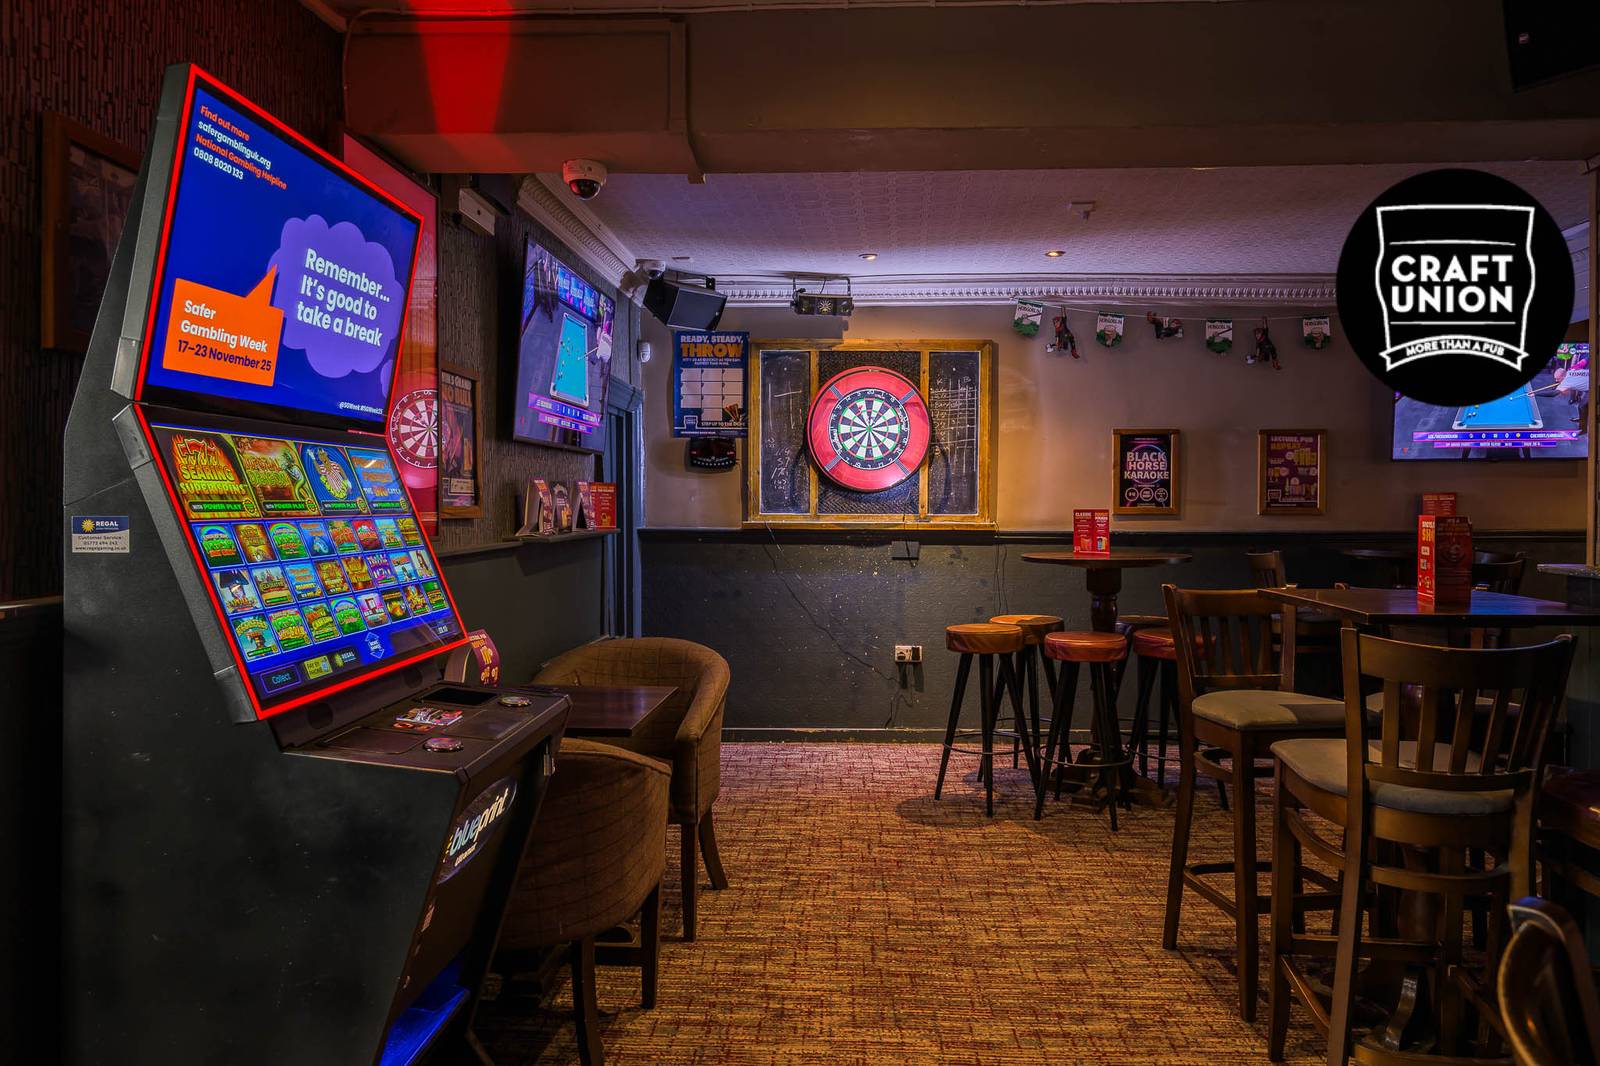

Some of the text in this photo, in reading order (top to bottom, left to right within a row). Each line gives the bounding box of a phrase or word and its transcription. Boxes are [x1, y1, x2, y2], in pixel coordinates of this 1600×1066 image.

[200, 105, 250, 141] Find out more
[198, 120, 272, 170] safergamblinguk.org
[194, 147, 244, 180] 0808 8020 133
[195, 133, 287, 190] National Gambling Helpline
[305, 248, 390, 302] Remember...
[184, 299, 216, 320] Safer
[326, 289, 363, 315] good
[364, 300, 377, 321] to
[297, 301, 383, 347] take a break
[181, 319, 268, 353] Gambling Week
[680, 335, 744, 344] READY, STEADY,
[208, 346, 260, 370] November
[260, 359, 272, 372] 25
[681, 343, 743, 358] THROW
[1126, 451, 1167, 462] BLACK
[1128, 461, 1167, 471] HORSE
[180, 465, 235, 481] SEARING
[1124, 471, 1170, 480] KARAOKE
[226, 503, 242, 511] PLAY
[271, 673, 292, 685] Collect
